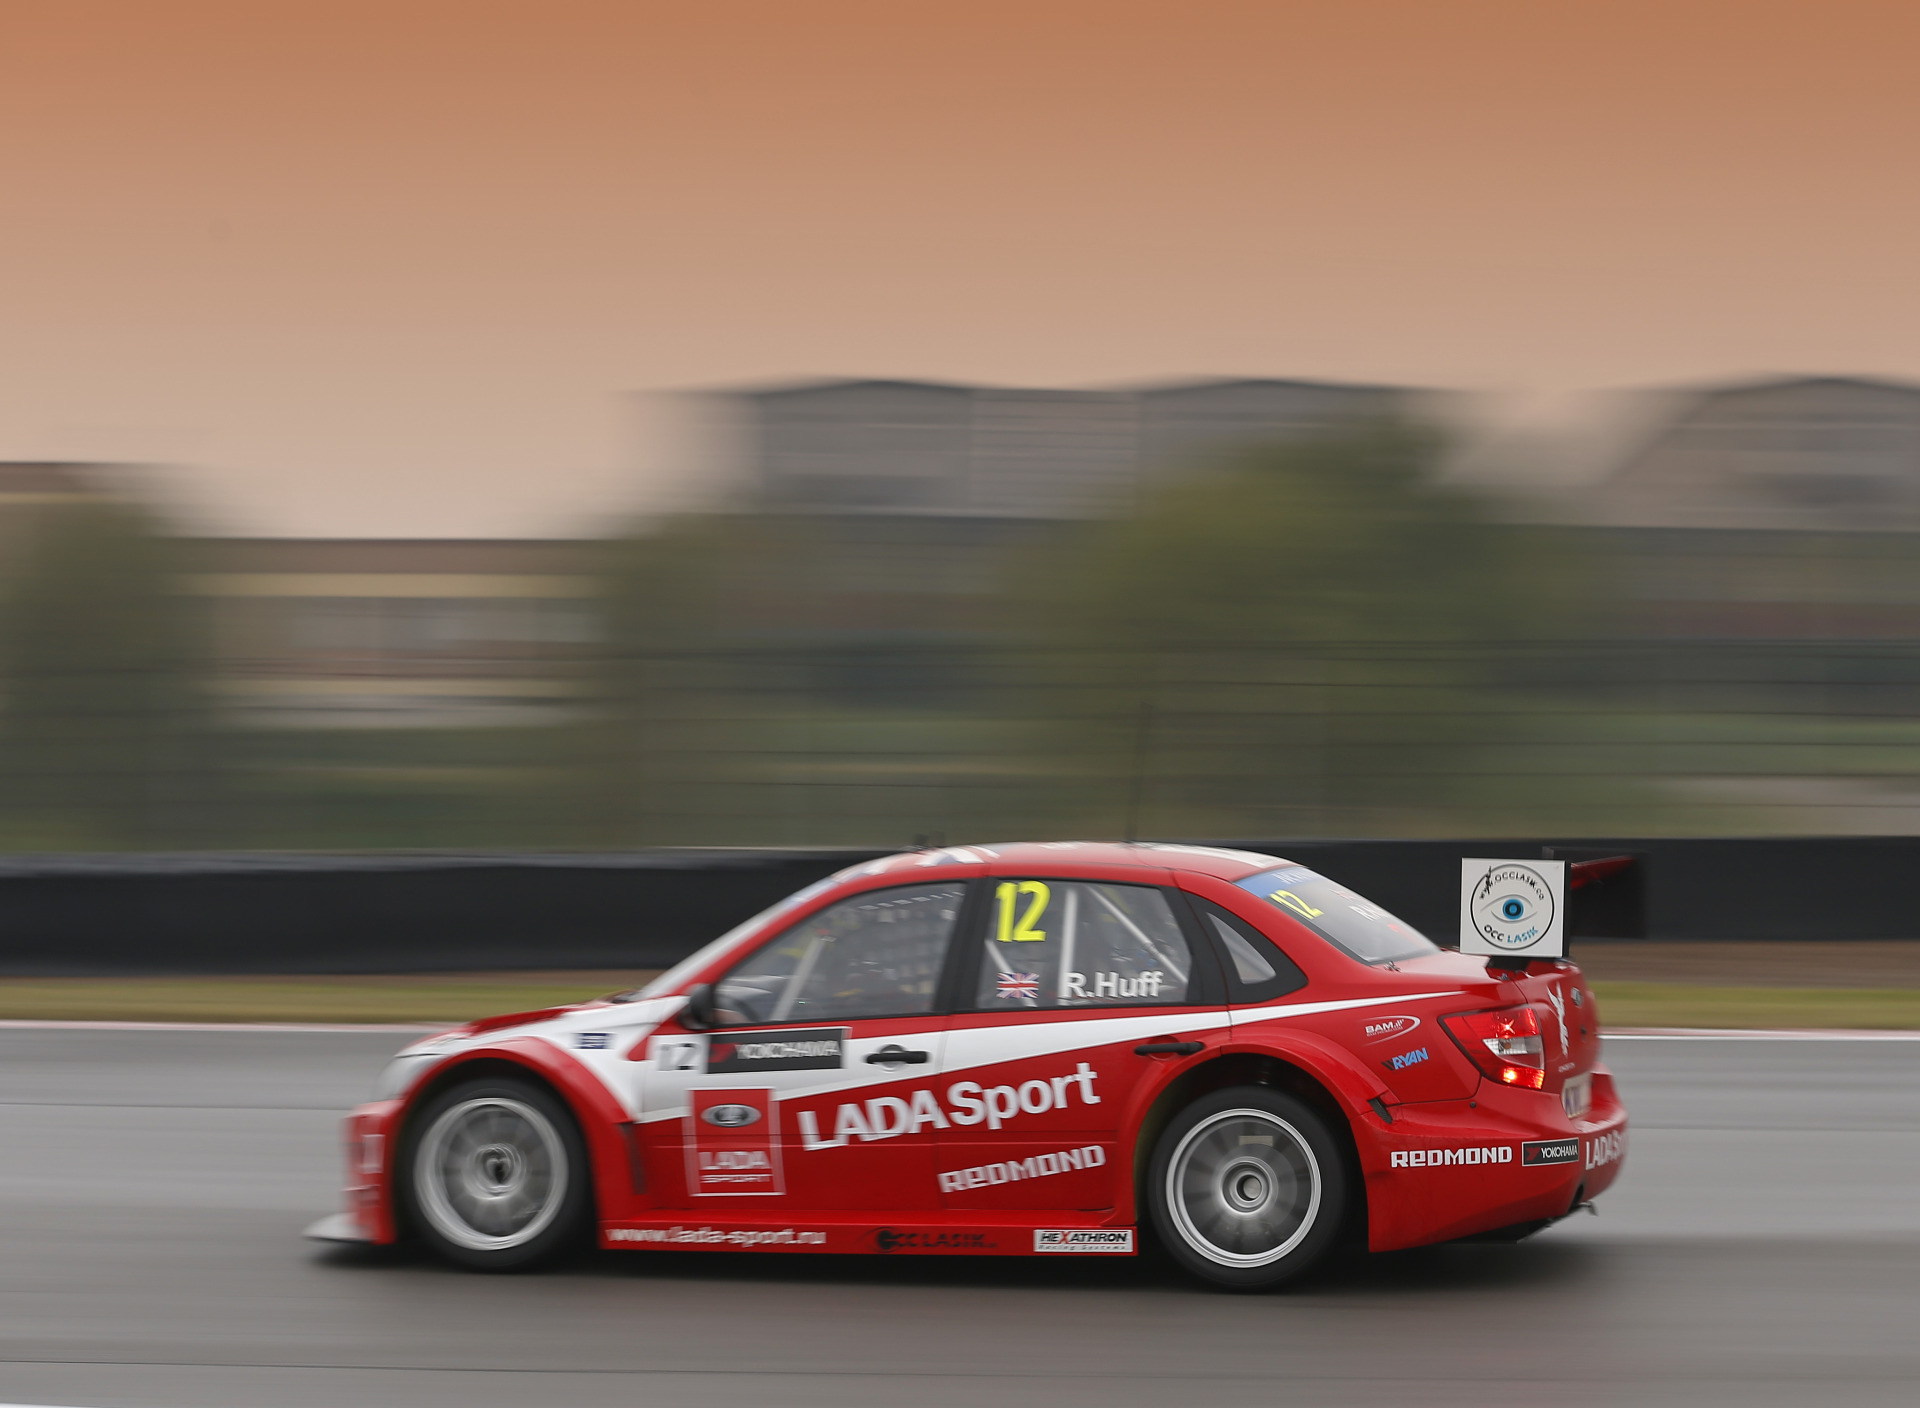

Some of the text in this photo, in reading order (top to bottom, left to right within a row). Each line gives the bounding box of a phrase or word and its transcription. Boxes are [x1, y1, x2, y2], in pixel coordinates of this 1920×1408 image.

[995, 880, 1050, 942] 12
[1269, 889, 1325, 920] 12
[1484, 924, 1538, 943] OCC LASIK
[1063, 970, 1164, 999] R.Huff
[1365, 1021, 1394, 1034] BAM
[1392, 1047, 1428, 1070] RYAN
[797, 1062, 1101, 1151] LADA Sport
[698, 1150, 772, 1170] LADA
[1390, 1146, 1512, 1168] REDMOND
[1541, 1144, 1578, 1159] YOKOHAMA
[938, 1144, 1106, 1193] REDMOND
[605, 1226, 826, 1248] www.lada-sport.ru
[1040, 1231, 1127, 1243] HEXATHRON
